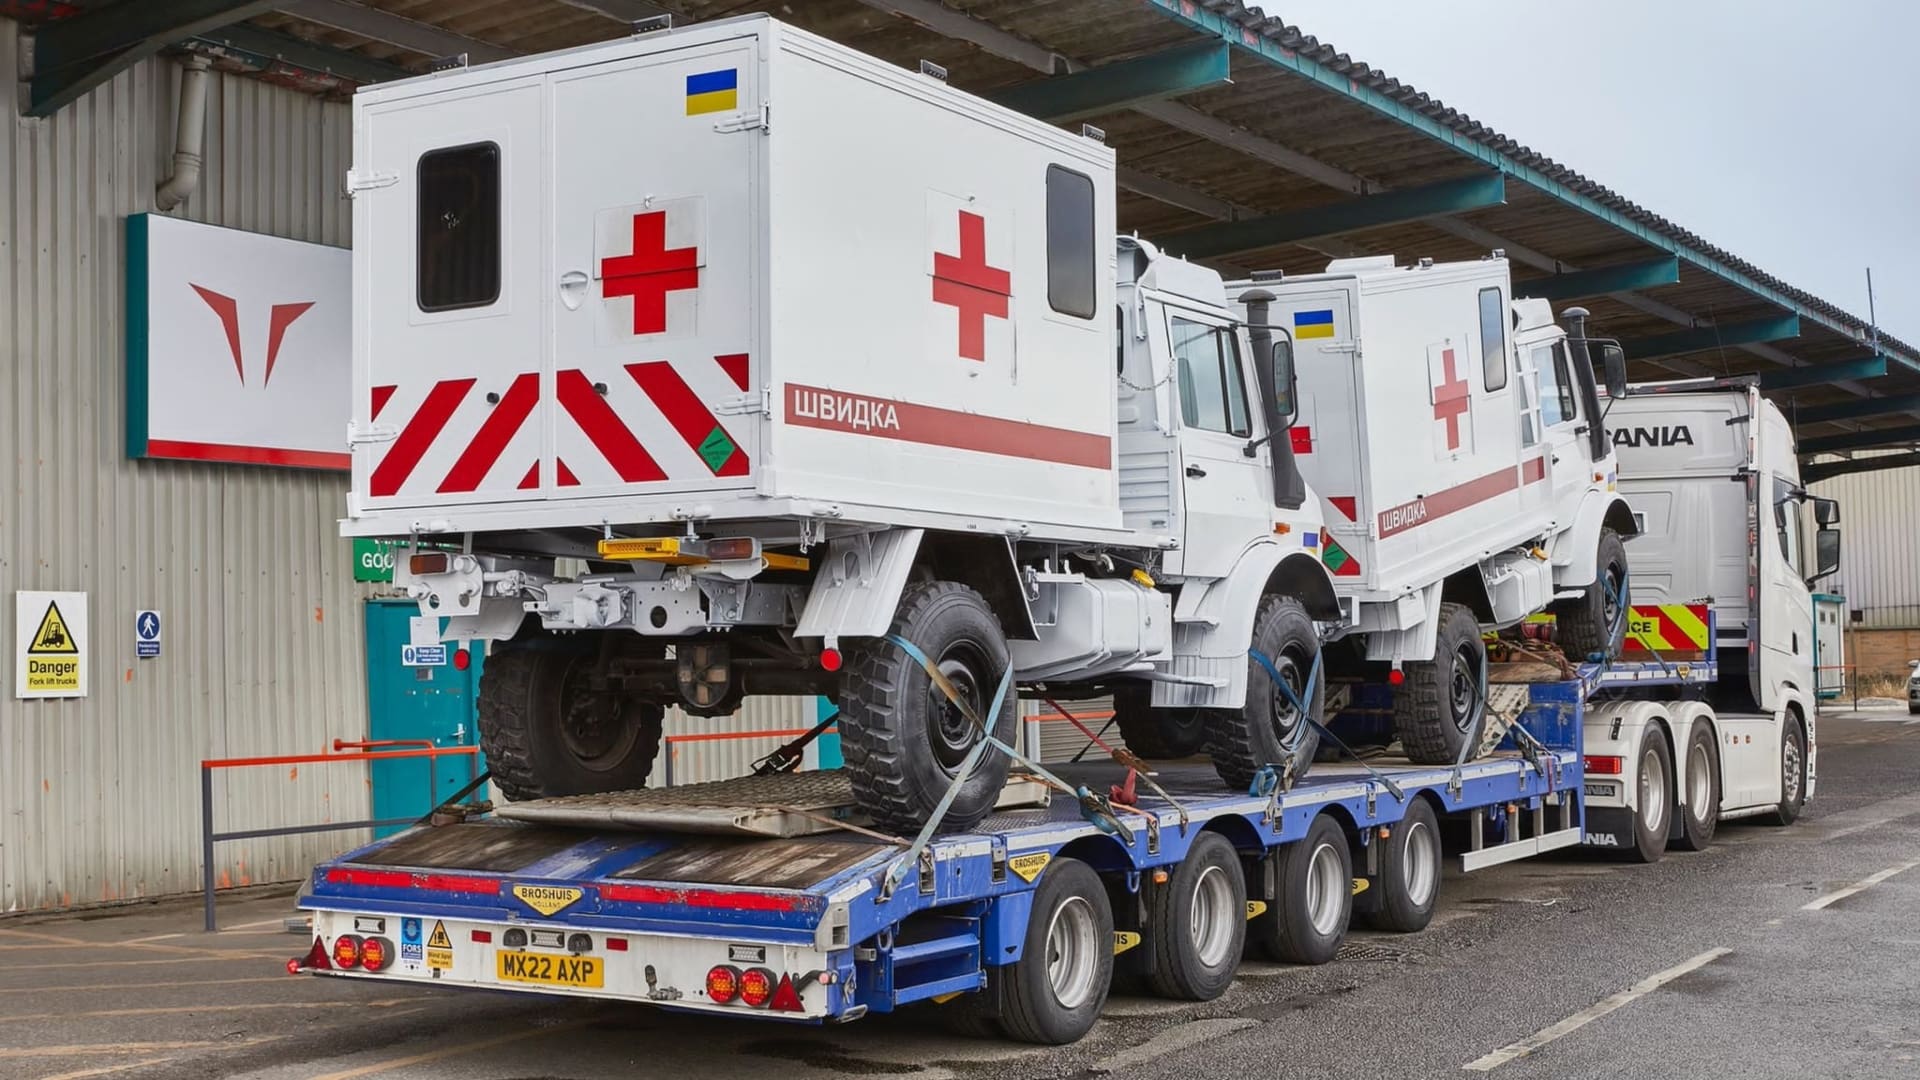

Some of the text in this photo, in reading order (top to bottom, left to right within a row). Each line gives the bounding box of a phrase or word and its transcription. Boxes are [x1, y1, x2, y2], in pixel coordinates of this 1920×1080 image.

[795, 389, 900, 432] ШВИДКА
[1605, 425, 1694, 448] ANIA
[1382, 500, 1428, 532] ШВИДКА
[29, 660, 77, 677] Danger
[29, 677, 77, 685] Fork lift trucks
[1583, 832, 1619, 846] NIA
[1014, 855, 1046, 869] BROSHUIS
[521, 888, 573, 901] BROSHUIS
[503, 954, 595, 984] MX22 AXP
